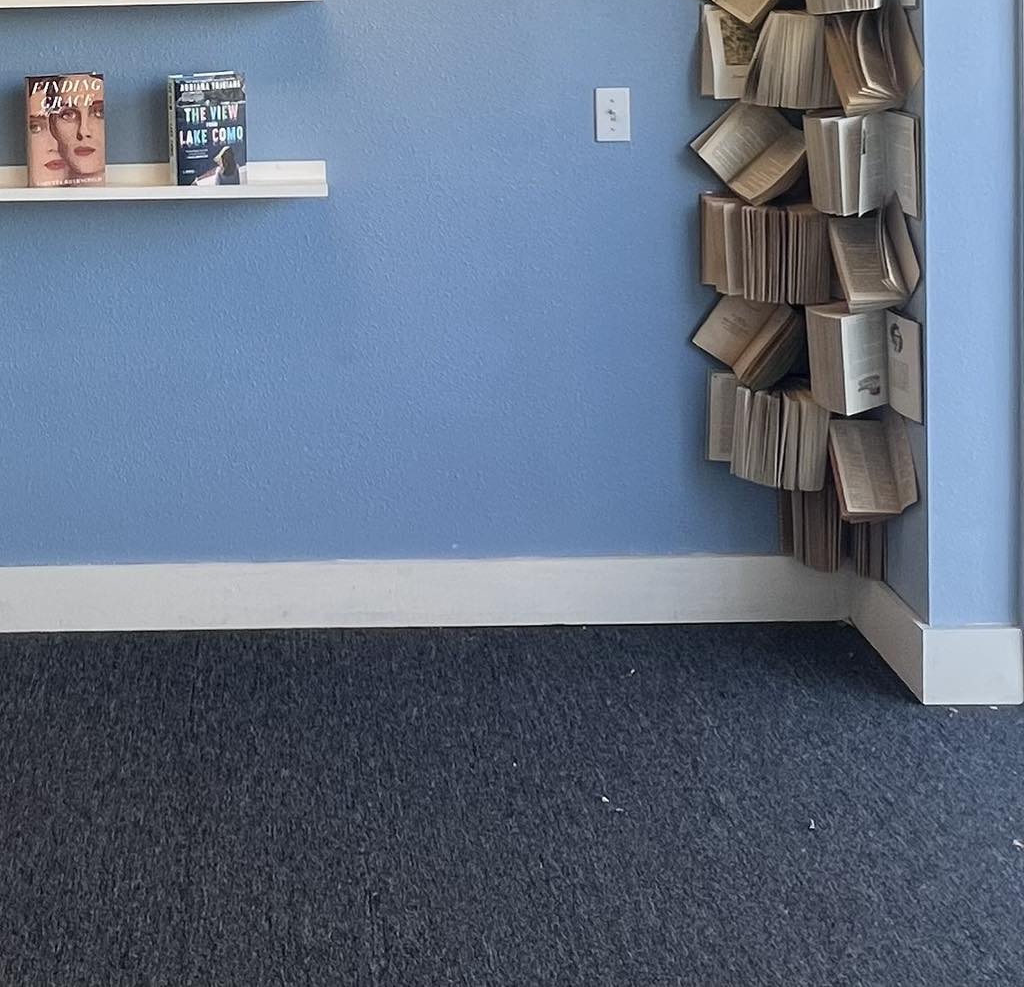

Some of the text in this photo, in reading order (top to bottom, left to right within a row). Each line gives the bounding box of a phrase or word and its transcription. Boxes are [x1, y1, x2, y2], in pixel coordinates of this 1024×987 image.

[32, 79, 101, 94] FINDING
[41, 94, 95, 109] GRACE
[184, 104, 238, 123] THE VIEW
[179, 126, 243, 146] LAKE COMO
